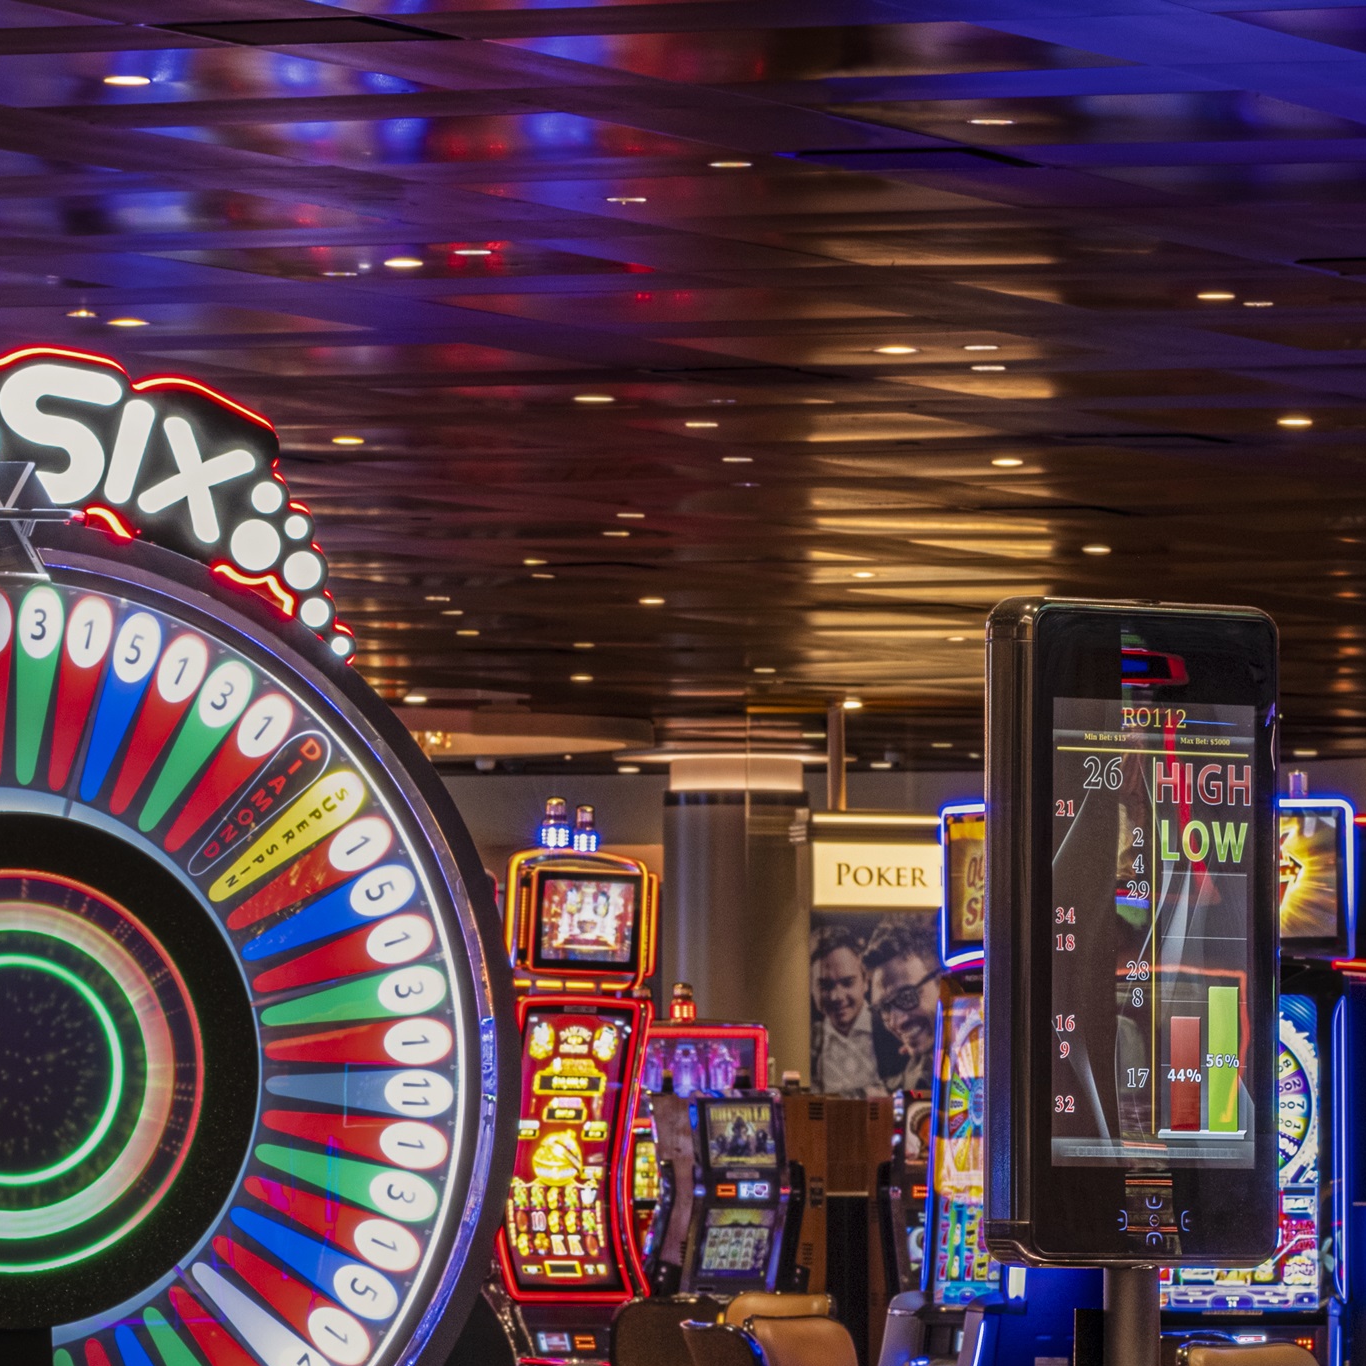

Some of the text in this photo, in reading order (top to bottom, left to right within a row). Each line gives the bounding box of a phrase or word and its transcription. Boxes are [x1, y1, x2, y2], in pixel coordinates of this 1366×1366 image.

[29, 608, 48, 641] 3
[83, 619, 95, 650] 1
[124, 634, 145, 665] 5
[174, 657, 191, 686] 1
[210, 681, 235, 711] 3
[253, 715, 275, 741] 1
[1084, 733, 1096, 741] Min
[1098, 733, 1113, 741] Bet:
[1180, 737, 1230, 746] Max Bet: $5000
[1083, 756, 1123, 790] 26
[1156, 762, 1251, 806] HIGH
[202, 736, 323, 859] DIAMOND
[1055, 800, 1074, 817] 21
[346, 835, 371, 856] 1
[1133, 827, 1144, 847] 2
[1161, 820, 1248, 863] LOW
[1132, 854, 1144, 873] 4
[836, 863, 929, 887] POKER
[365, 880, 395, 902] 5
[1126, 881, 1150, 900] 29
[1055, 907, 1075, 924] 34
[384, 932, 411, 948] 1
[1056, 934, 1075, 951] 18
[1126, 961, 1150, 980] 28
[394, 981, 424, 999] 3
[1132, 988, 1144, 1007] 8
[1056, 1015, 1075, 1032] 16
[401, 1036, 430, 1048] 1
[1060, 1042, 1070, 1058] 9
[1205, 1054, 1240, 1068] 56%
[1127, 1068, 1149, 1087] 17
[1167, 1069, 1202, 1083] 44%
[402, 1077, 431, 1109] 11
[1055, 1095, 1075, 1112] 32
[397, 1141, 426, 1151] 1
[386, 1183, 417, 1204] 3
[370, 1237, 398, 1254] 1
[349, 1276, 378, 1302] 5
[323, 1325, 349, 1346] 1
